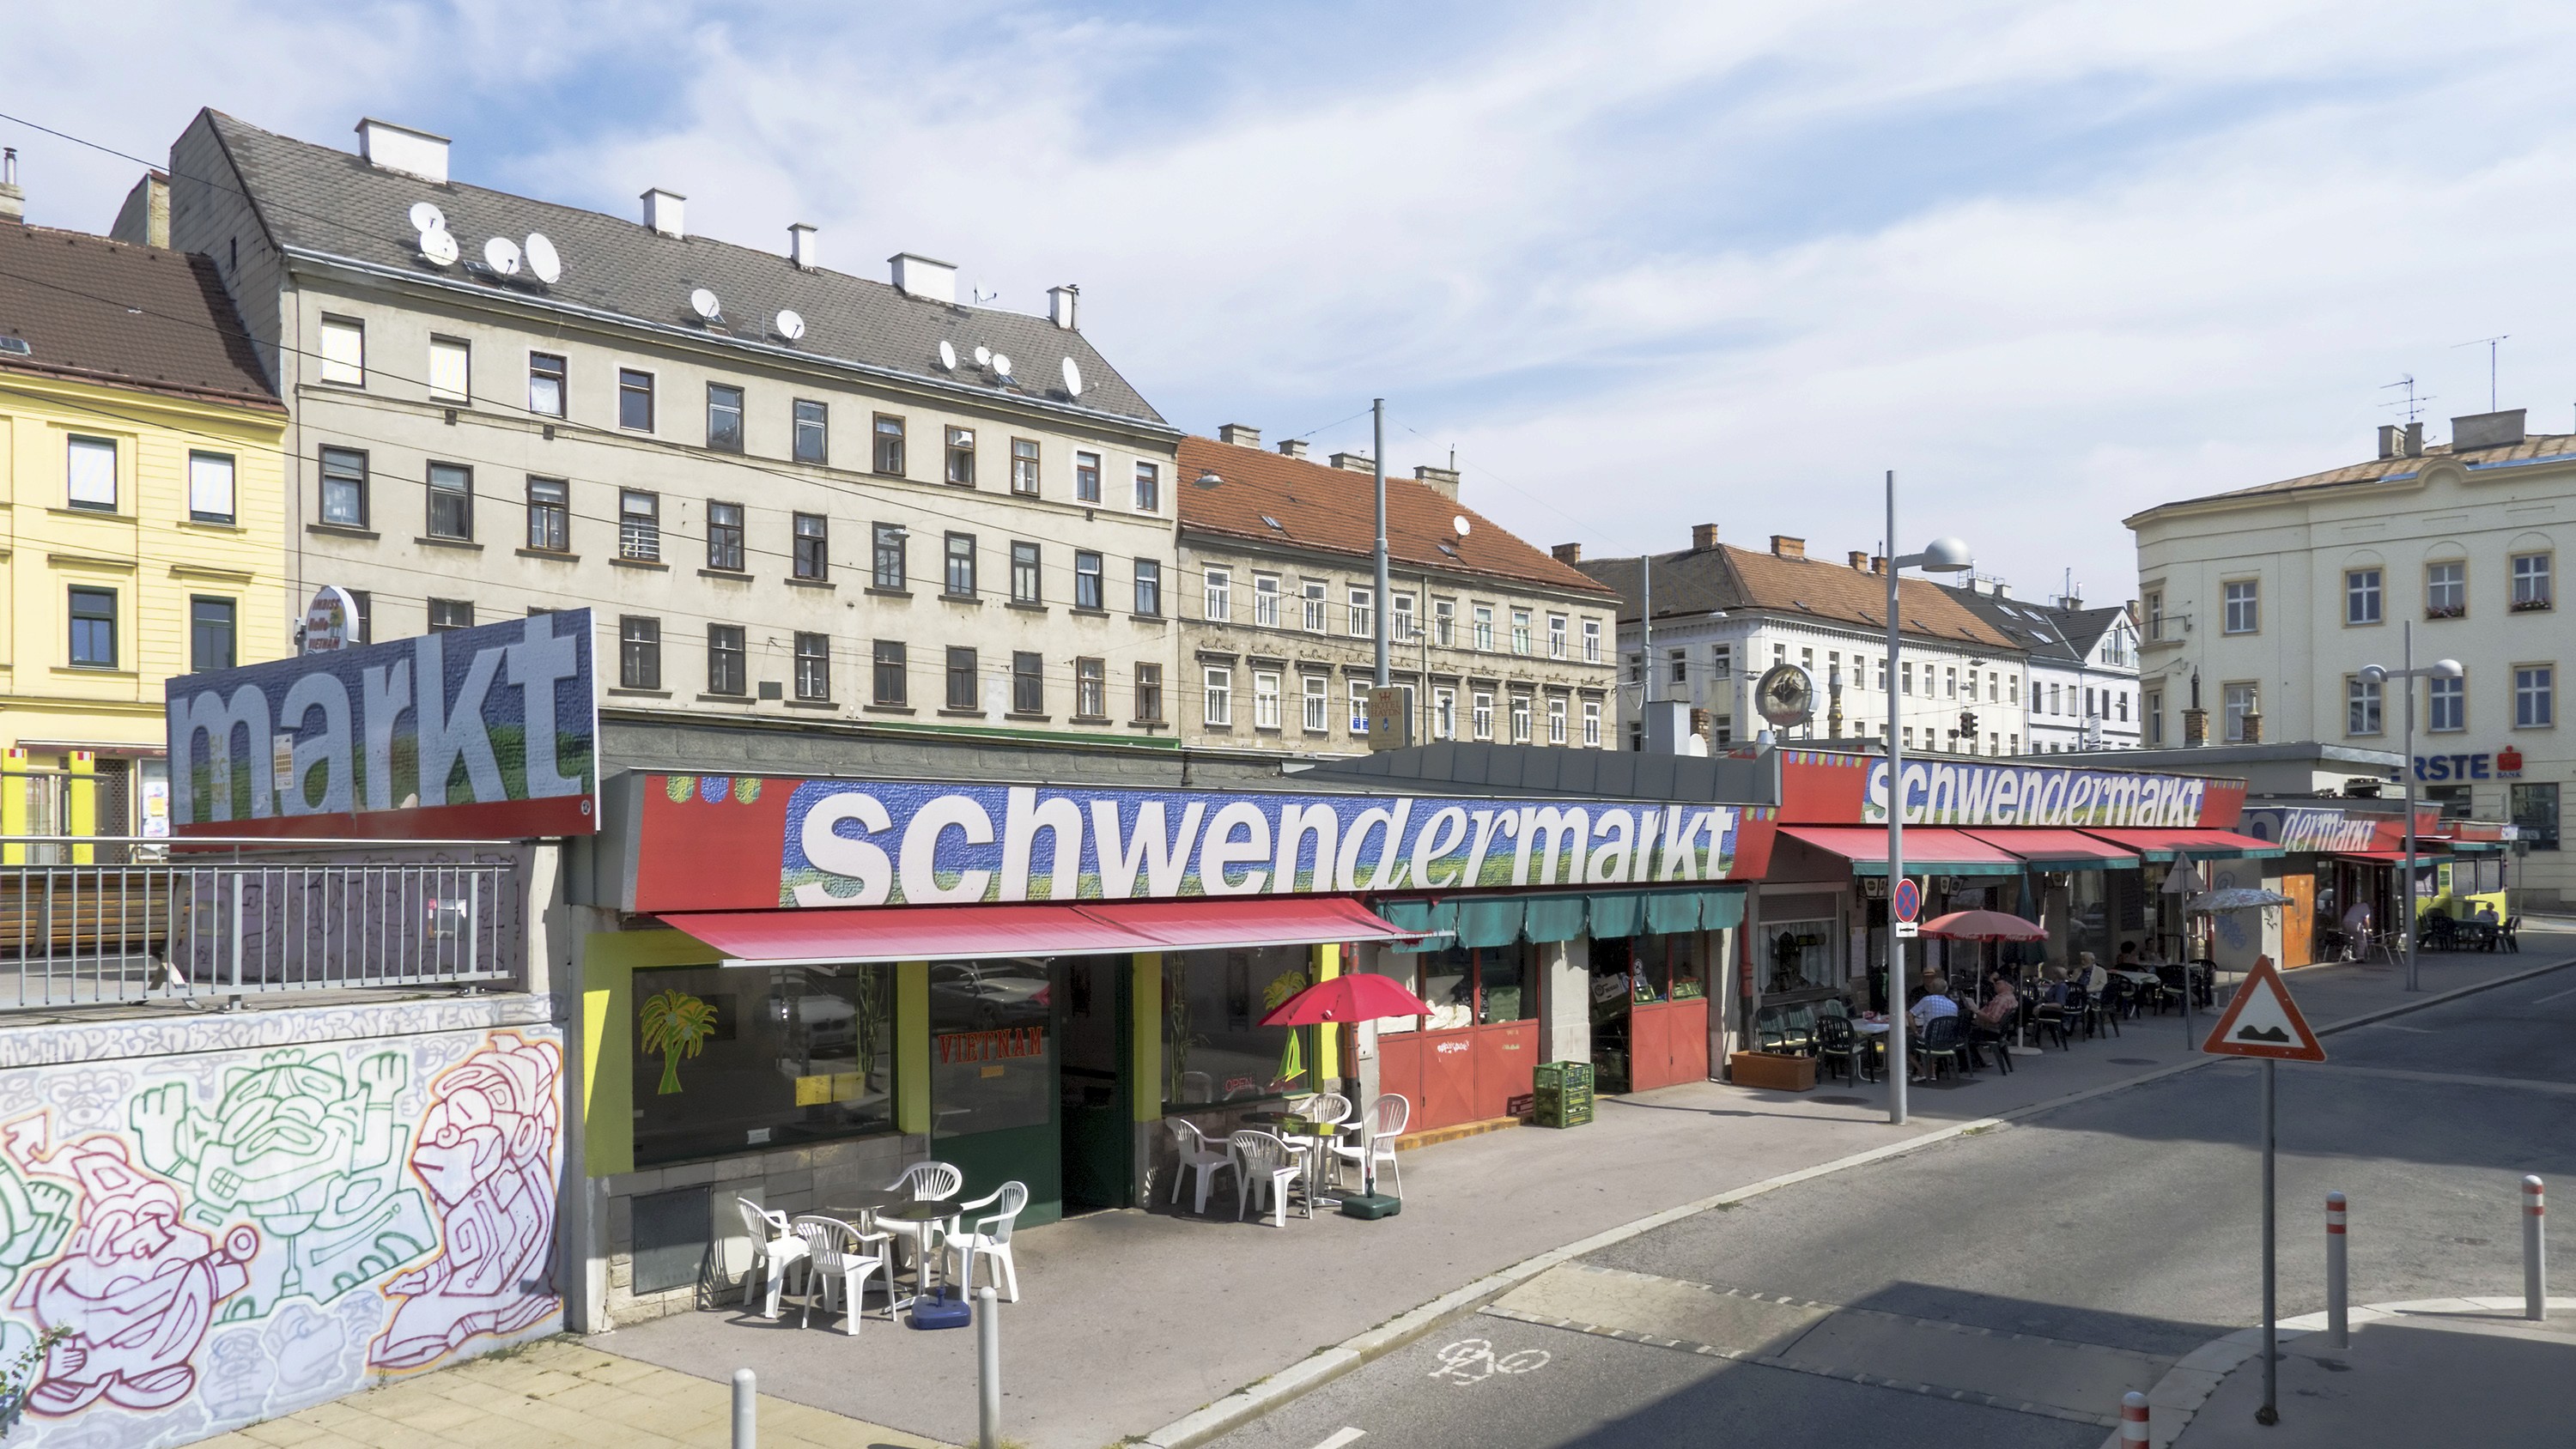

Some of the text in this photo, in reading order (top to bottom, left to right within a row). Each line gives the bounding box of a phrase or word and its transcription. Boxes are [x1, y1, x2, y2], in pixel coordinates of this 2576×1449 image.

[308, 637, 340, 650] VIETNAM
[171, 613, 582, 825] markt
[1370, 700, 1401, 710] HOTEL
[1370, 708, 1401, 717] HAYDN
[2391, 754, 2489, 782] RSTE
[1865, 762, 2204, 827] schwendermarkt
[793, 786, 1735, 907] schwendermarkt
[938, 1026, 1043, 1064] VIETNAM
[1224, 1076, 1253, 1091] OPEN
